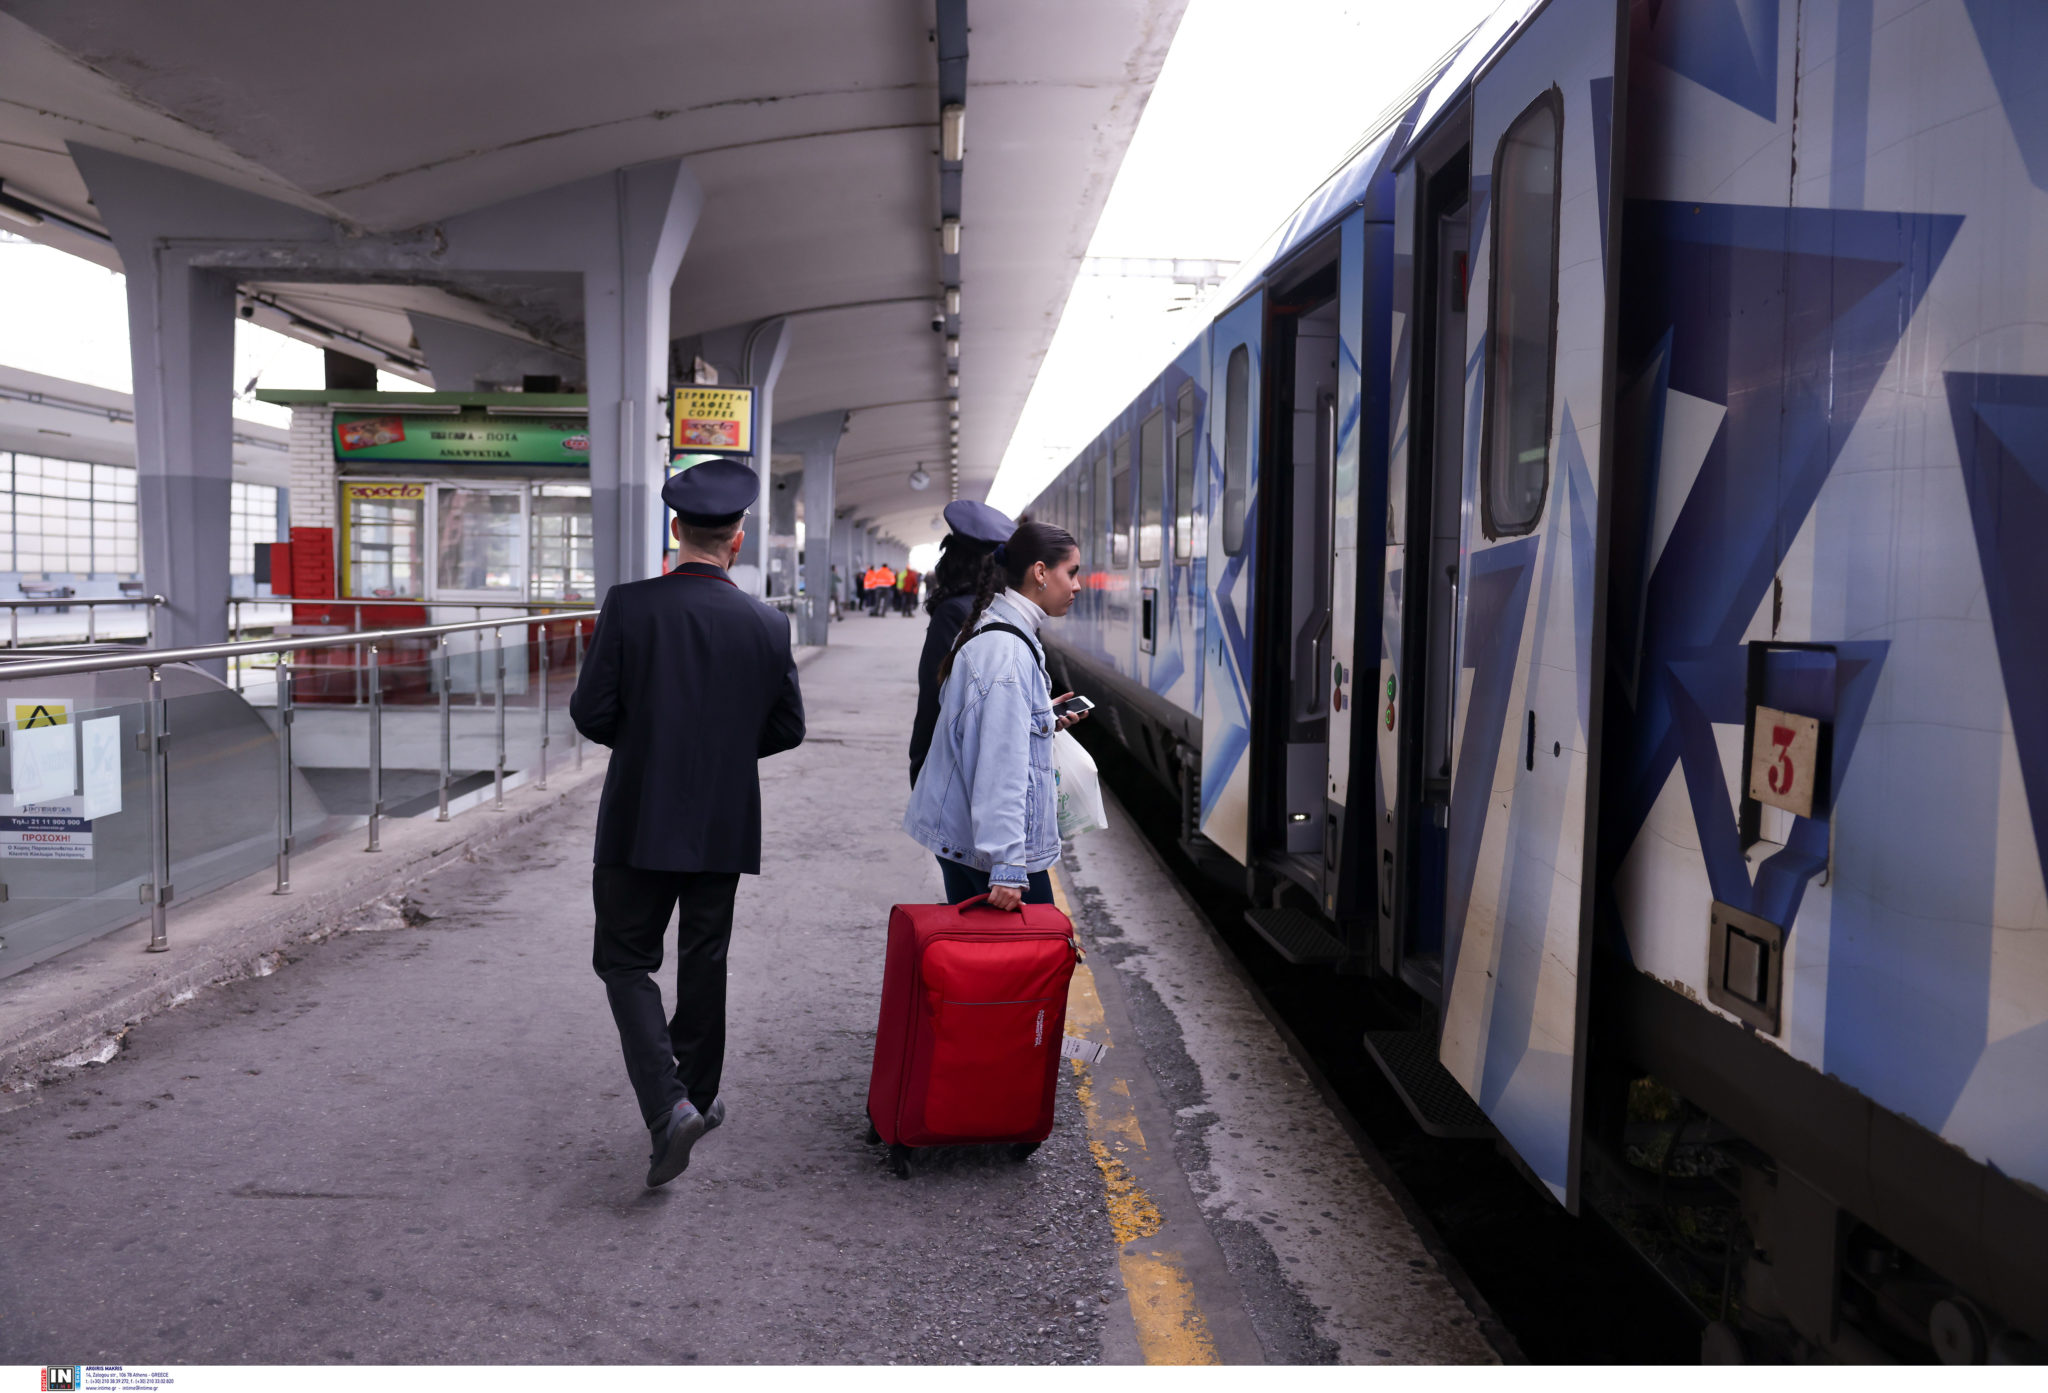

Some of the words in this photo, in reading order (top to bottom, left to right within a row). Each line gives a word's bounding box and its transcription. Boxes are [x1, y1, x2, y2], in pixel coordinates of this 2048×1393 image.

[691, 401, 732, 409] ΚΑΦΕΣ
[688, 410, 735, 418] COFFEE
[487, 432, 518, 441] ΠΟΤΑ
[440, 449, 511, 458] ΑΝΑΨΥΚΤΙΚΑ
[1768, 725, 1796, 795] 3
[22, 834, 71, 842] ΠΡΟΣΟΧΗ!
